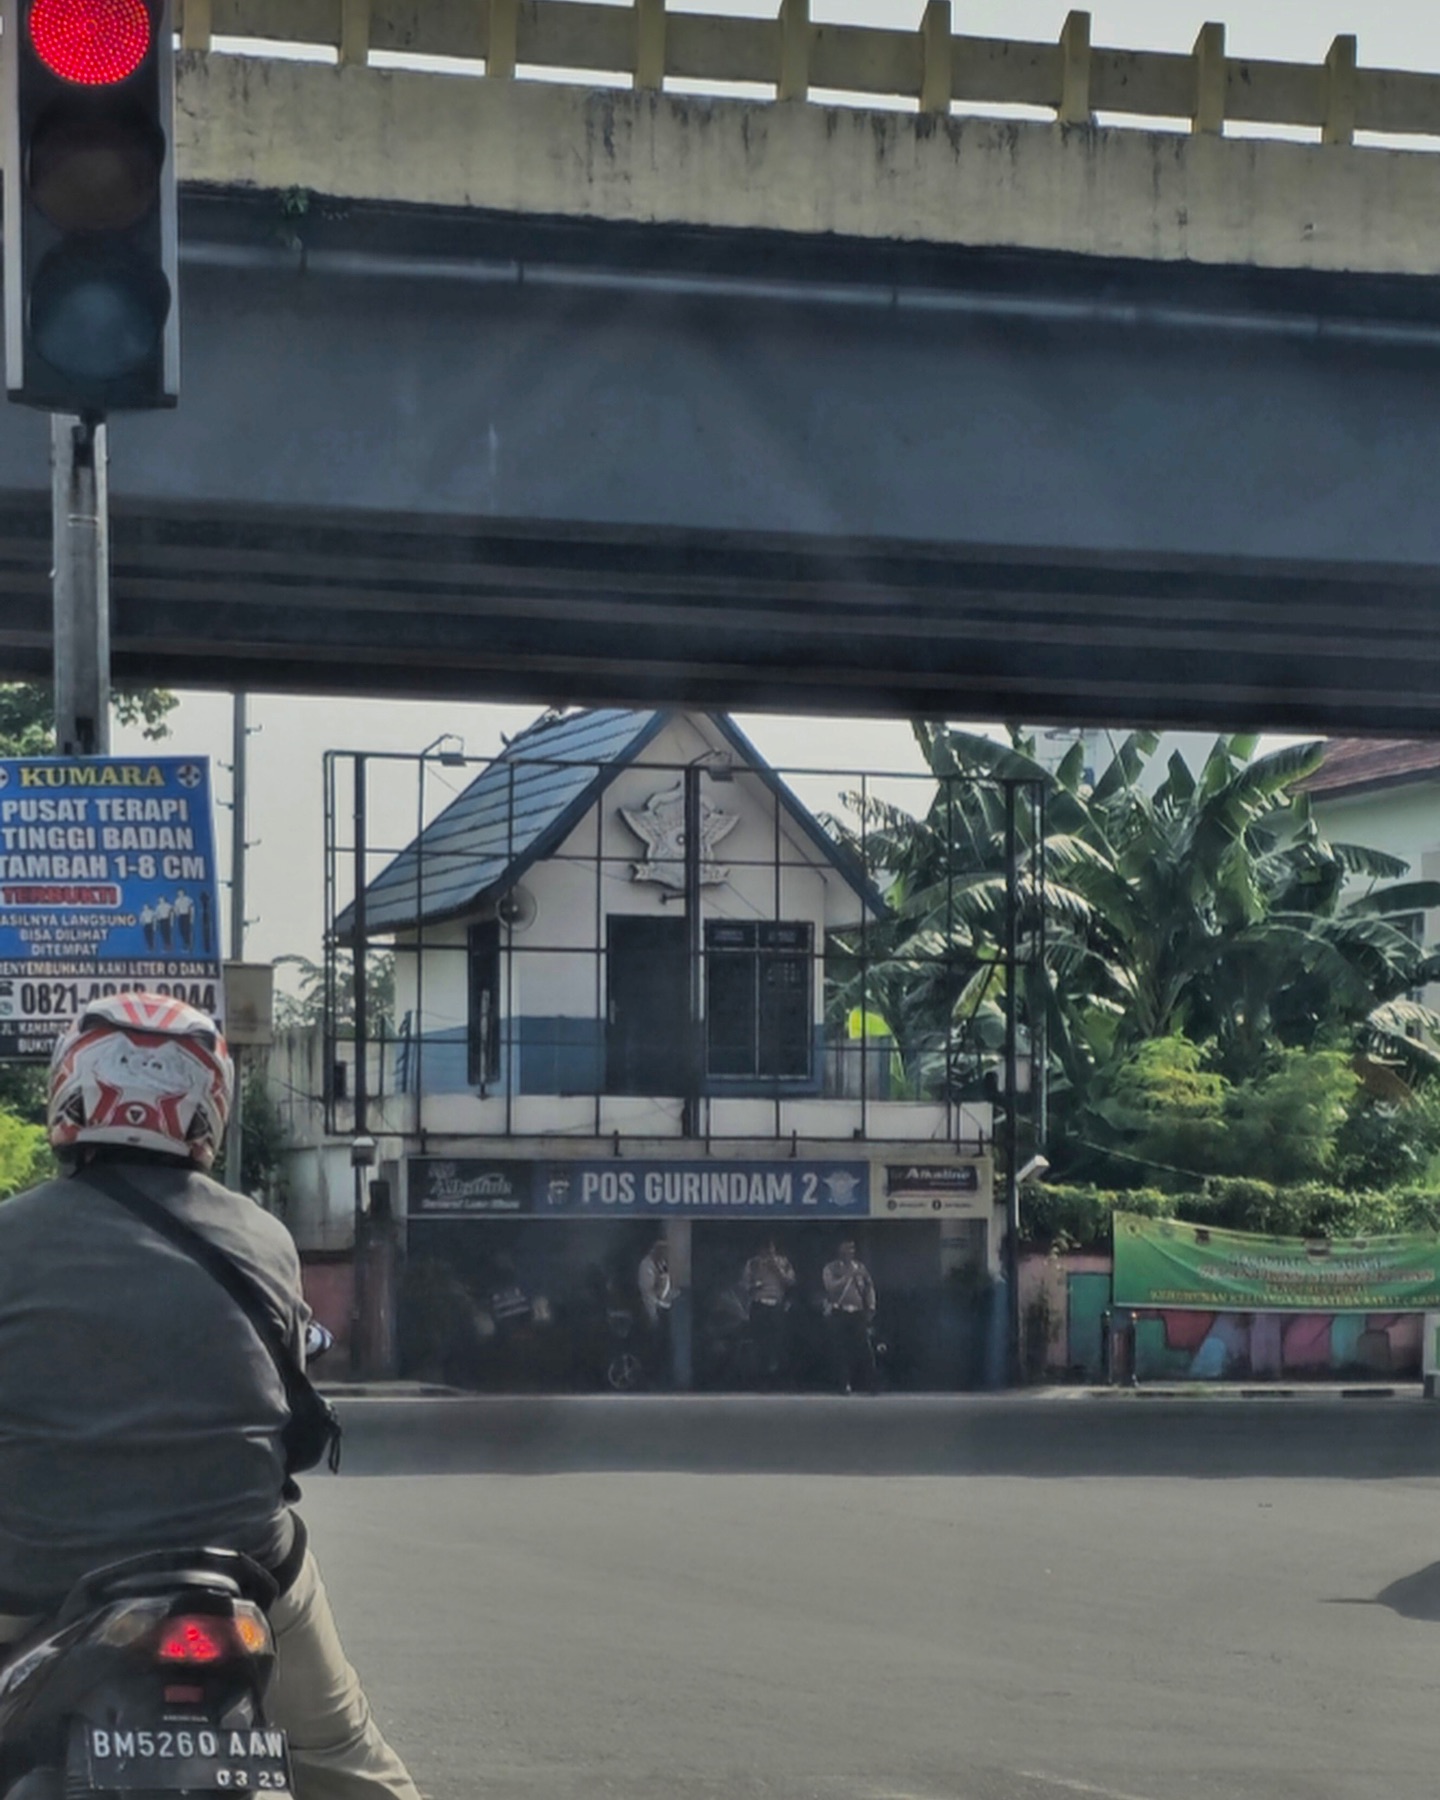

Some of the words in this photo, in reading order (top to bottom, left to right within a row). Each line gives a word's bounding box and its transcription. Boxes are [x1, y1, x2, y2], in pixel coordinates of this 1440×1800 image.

[20, 766, 165, 787] KUMARA
[3, 798, 88, 822] PUSAT
[96, 799, 188, 822] TERAPI
[2, 826, 95, 850] TINGGI
[103, 827, 193, 851] BADAN
[0, 855, 108, 879] TAMBAH
[115, 855, 155, 879] 1-8
[163, 856, 205, 880] CM
[0, 914, 58, 926] ASILNYA
[61, 914, 136, 927] LANGSUNG
[20, 929, 51, 941] BISA
[56, 929, 108, 941] DILIHAT
[31, 943, 98, 956] DITEMPAT
[0, 961, 95, 976] ENYEMBUHKAN
[129, 962, 165, 976] LETER
[180, 962, 204, 976] DAN
[207, 963, 216, 976] X
[582, 1172, 635, 1205] POS
[644, 1172, 793, 1205] GURINDAM
[801, 1173, 819, 1205] 2
[229, 1731, 284, 1758] AAW
